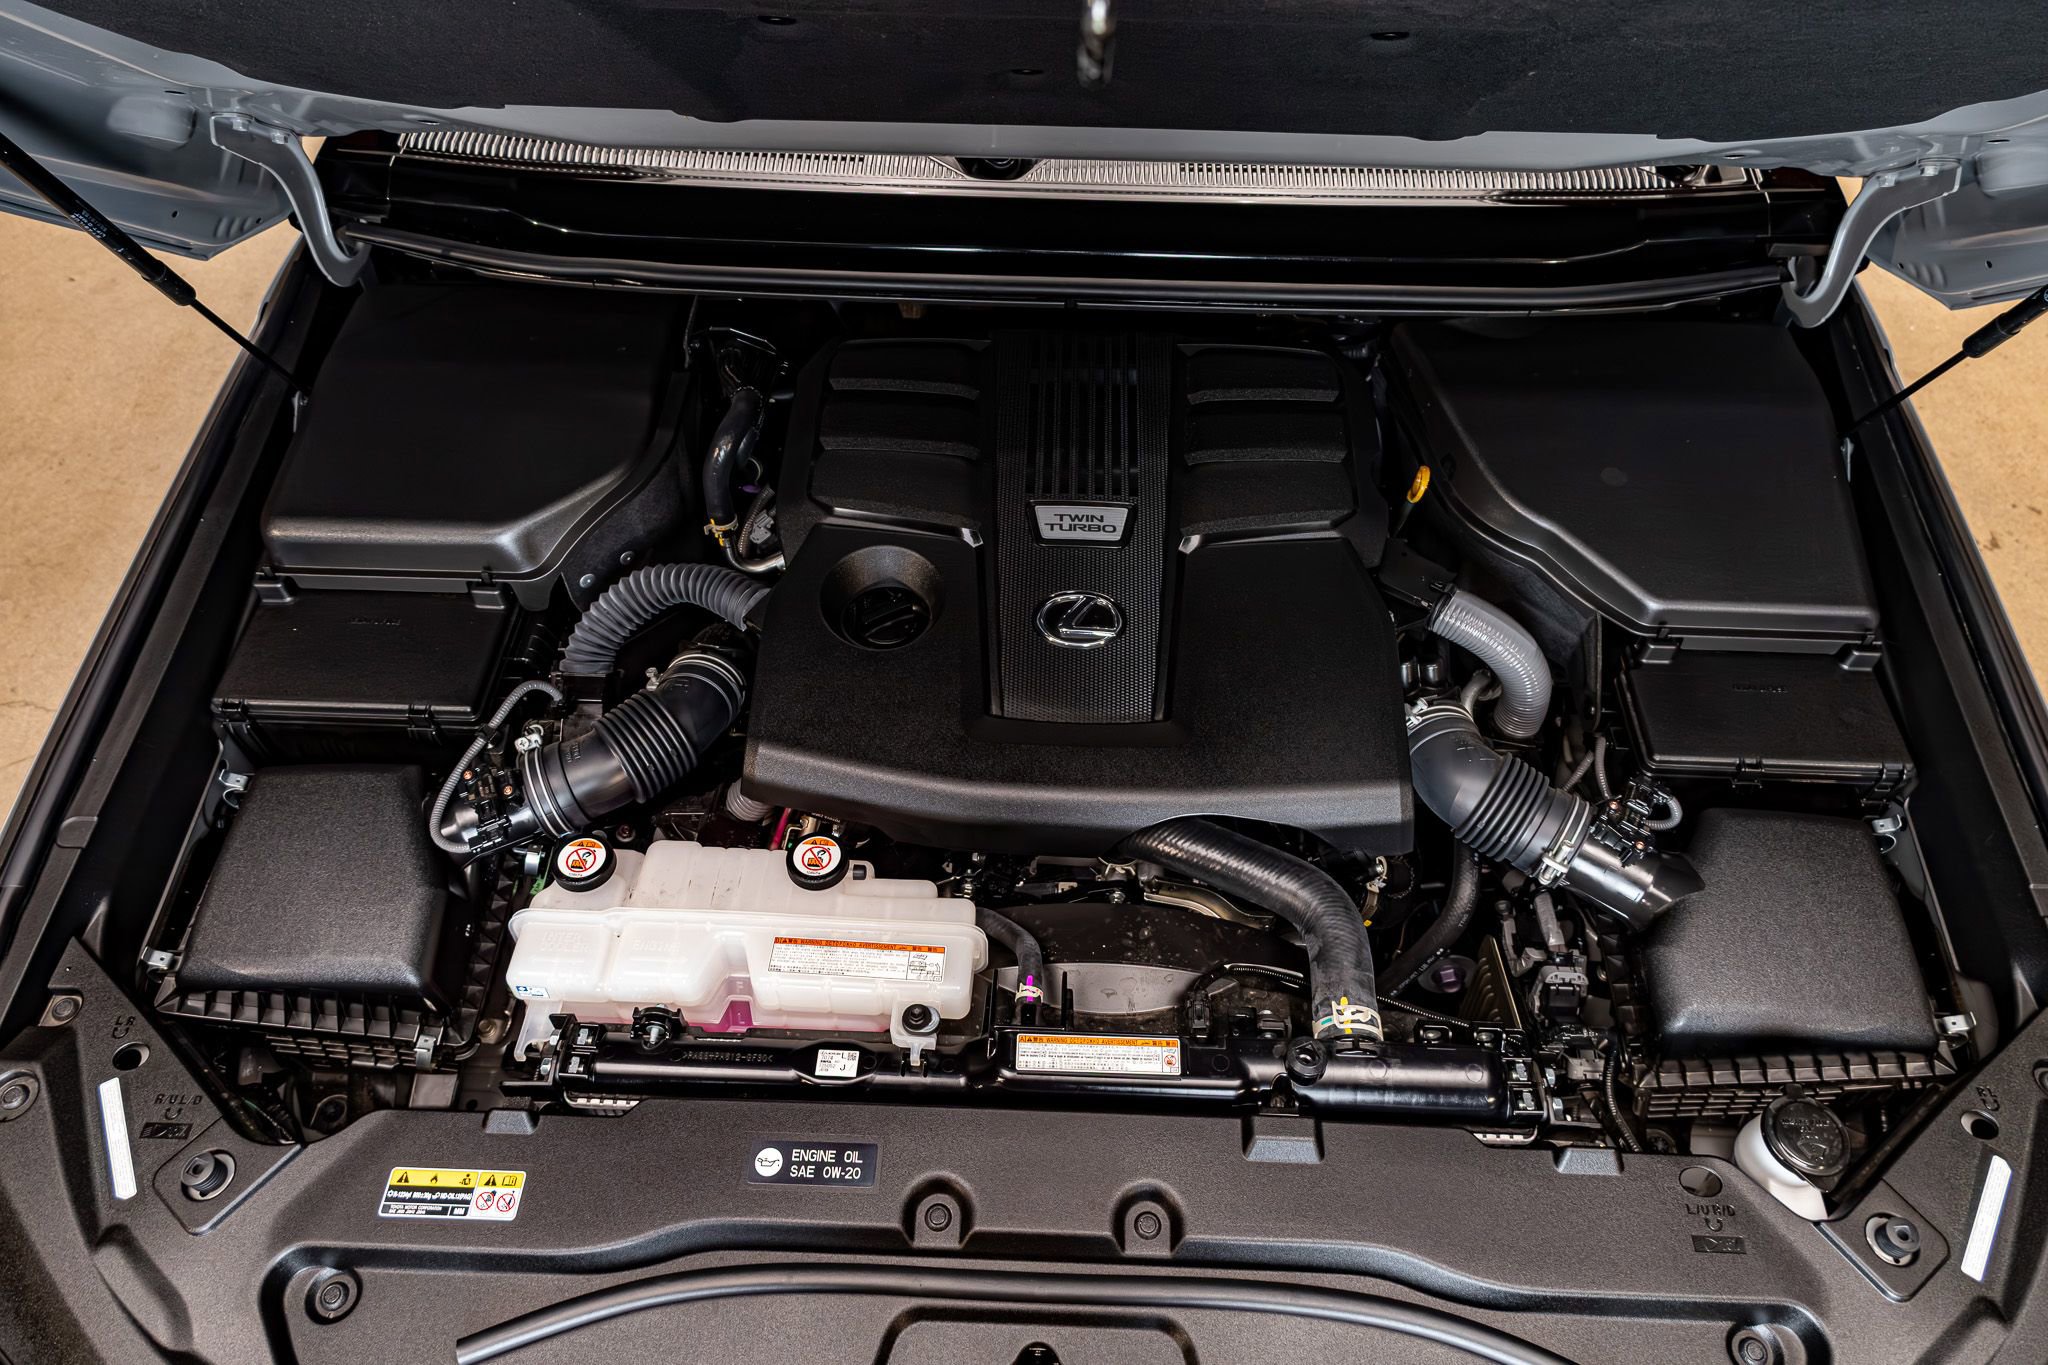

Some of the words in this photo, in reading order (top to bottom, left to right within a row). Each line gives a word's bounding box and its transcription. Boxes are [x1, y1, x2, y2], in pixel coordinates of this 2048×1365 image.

[1054, 513, 1104, 523] TWIN
[1044, 523, 1117, 534] TURBO
[791, 1149, 837, 1163] ENGINE
[844, 1151, 863, 1163] OIL
[789, 1165, 816, 1178] SAE
[822, 1166, 862, 1180] 0W-20
